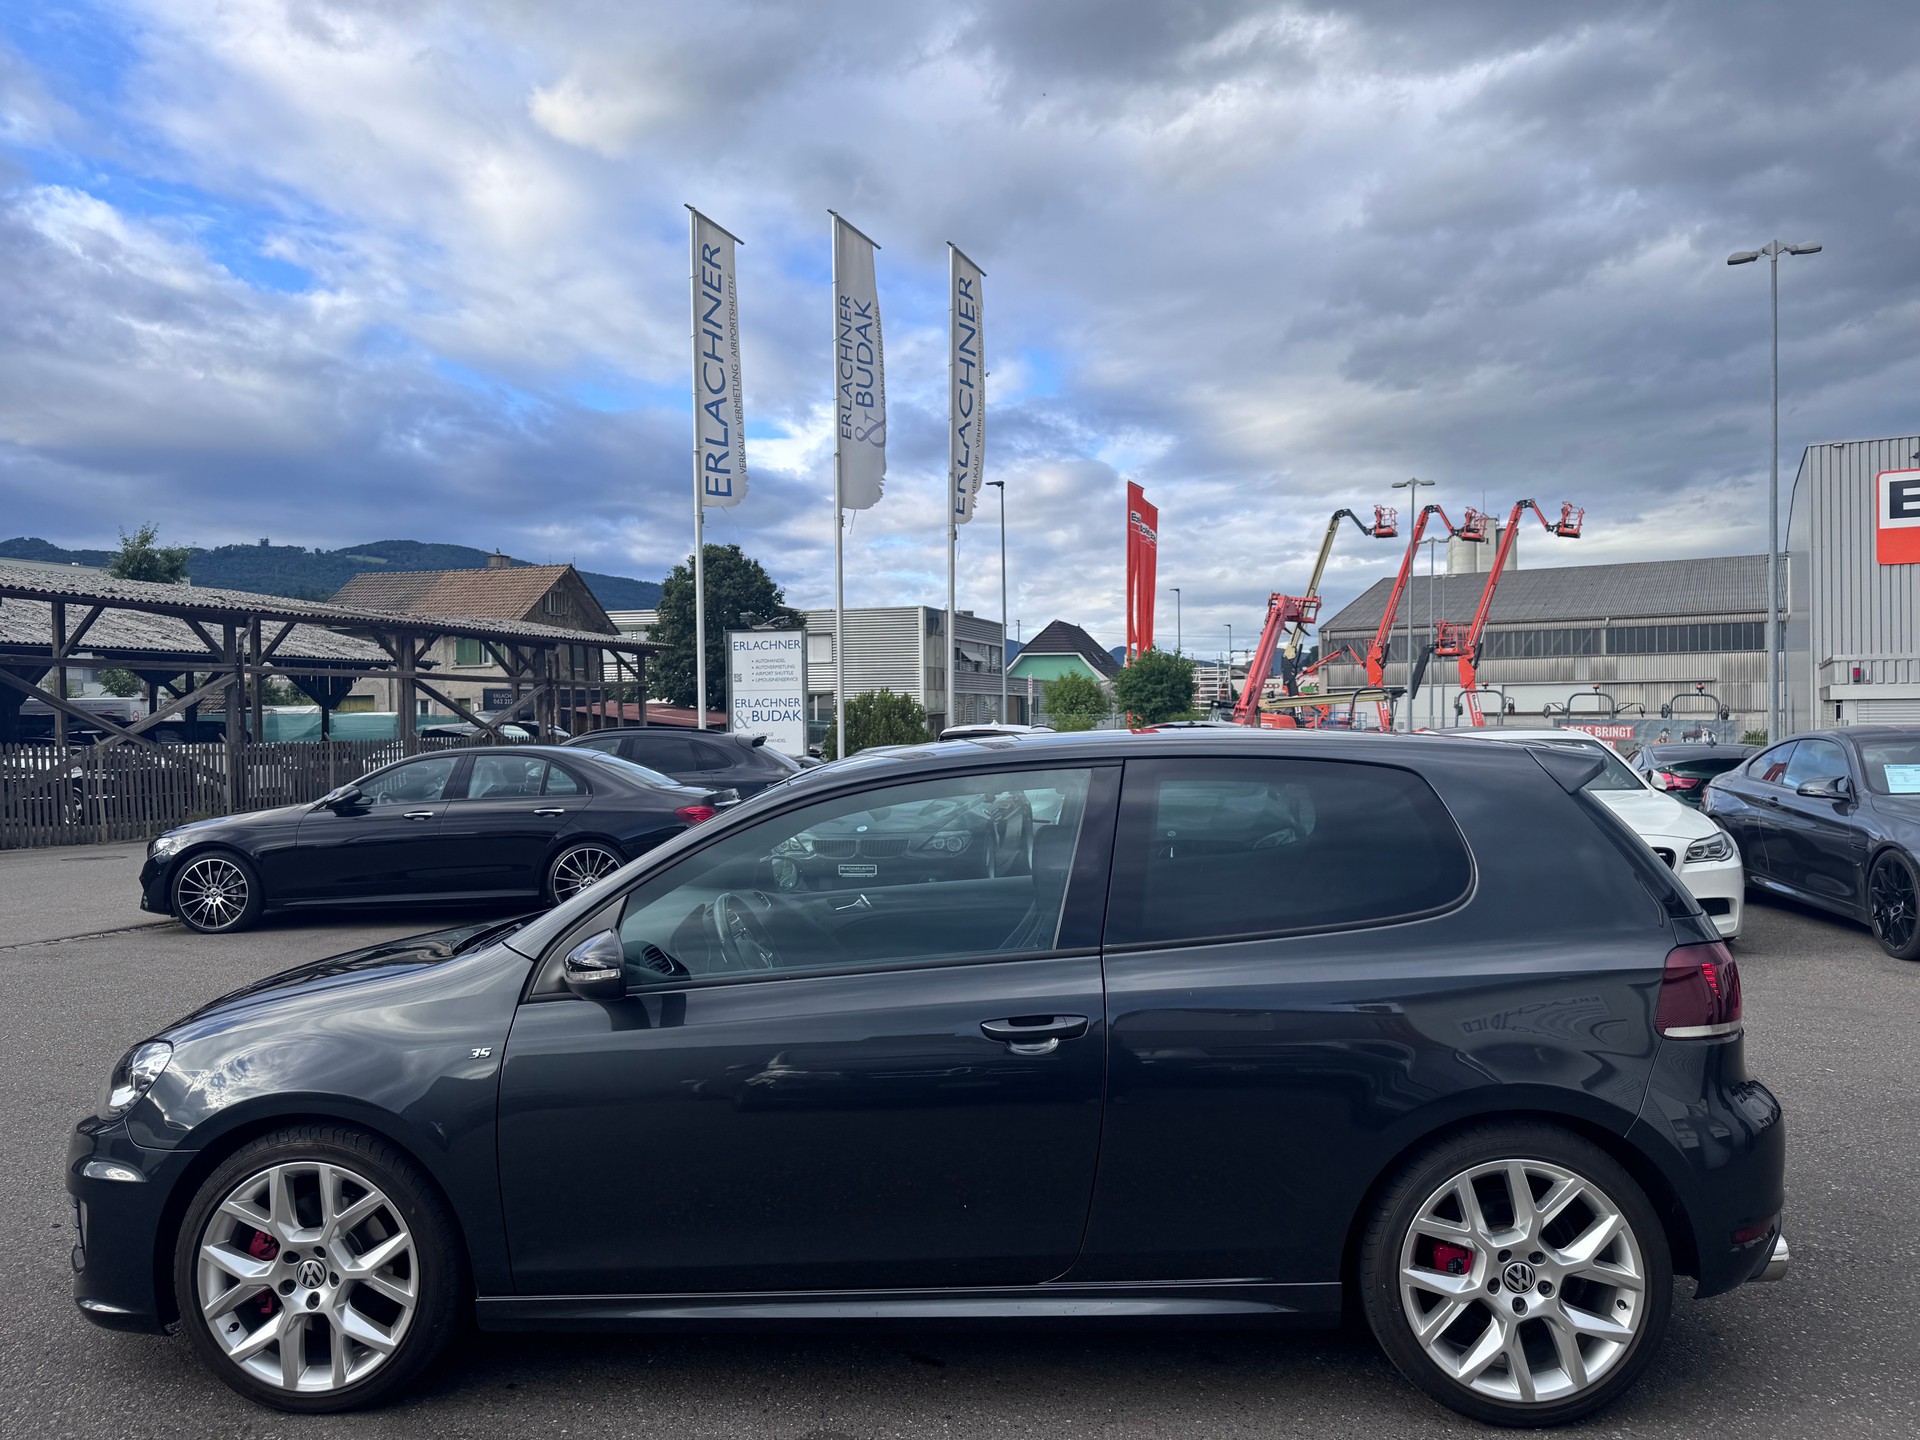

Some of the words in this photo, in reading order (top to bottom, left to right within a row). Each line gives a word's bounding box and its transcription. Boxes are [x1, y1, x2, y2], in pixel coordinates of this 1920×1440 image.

[727, 273, 738, 358] AIRPORTSHUTTLE
[702, 243, 732, 497] ERLACHNER
[840, 295, 853, 440] ERLACHNER
[854, 298, 875, 408] BUDAK
[731, 363, 742, 427] VERMIETUNG
[956, 277, 976, 515] ERLACHNER
[855, 410, 887, 448] &
[738, 431, 747, 475] VERKAUF
[733, 639, 801, 651] ERLACHNER
[734, 710, 751, 729] &
[752, 710, 802, 721] BUDAK
[735, 697, 801, 708] ERLACHNER
[1594, 726, 1632, 737] BRINGT
[469, 1047, 492, 1059] 35
